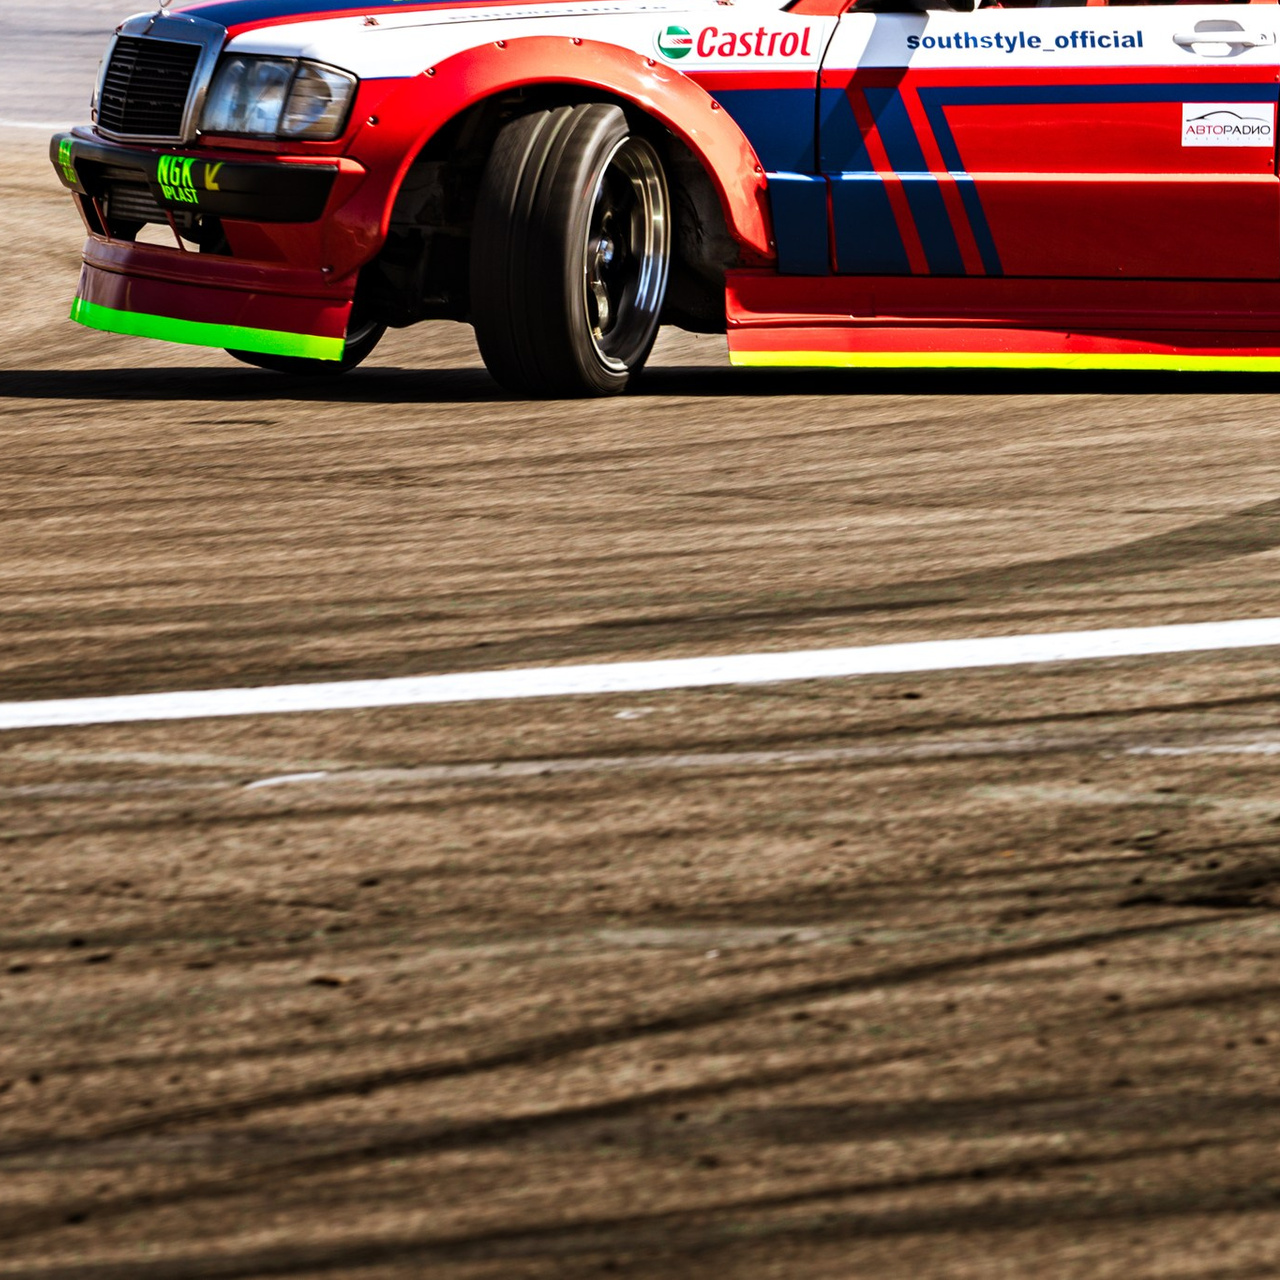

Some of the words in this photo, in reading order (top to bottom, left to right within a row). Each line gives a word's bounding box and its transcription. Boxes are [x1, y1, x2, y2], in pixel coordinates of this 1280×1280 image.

[696, 26, 811, 58] Castrol
[906, 30, 1144, 54] southstyle_official
[157, 155, 198, 188] NGK
